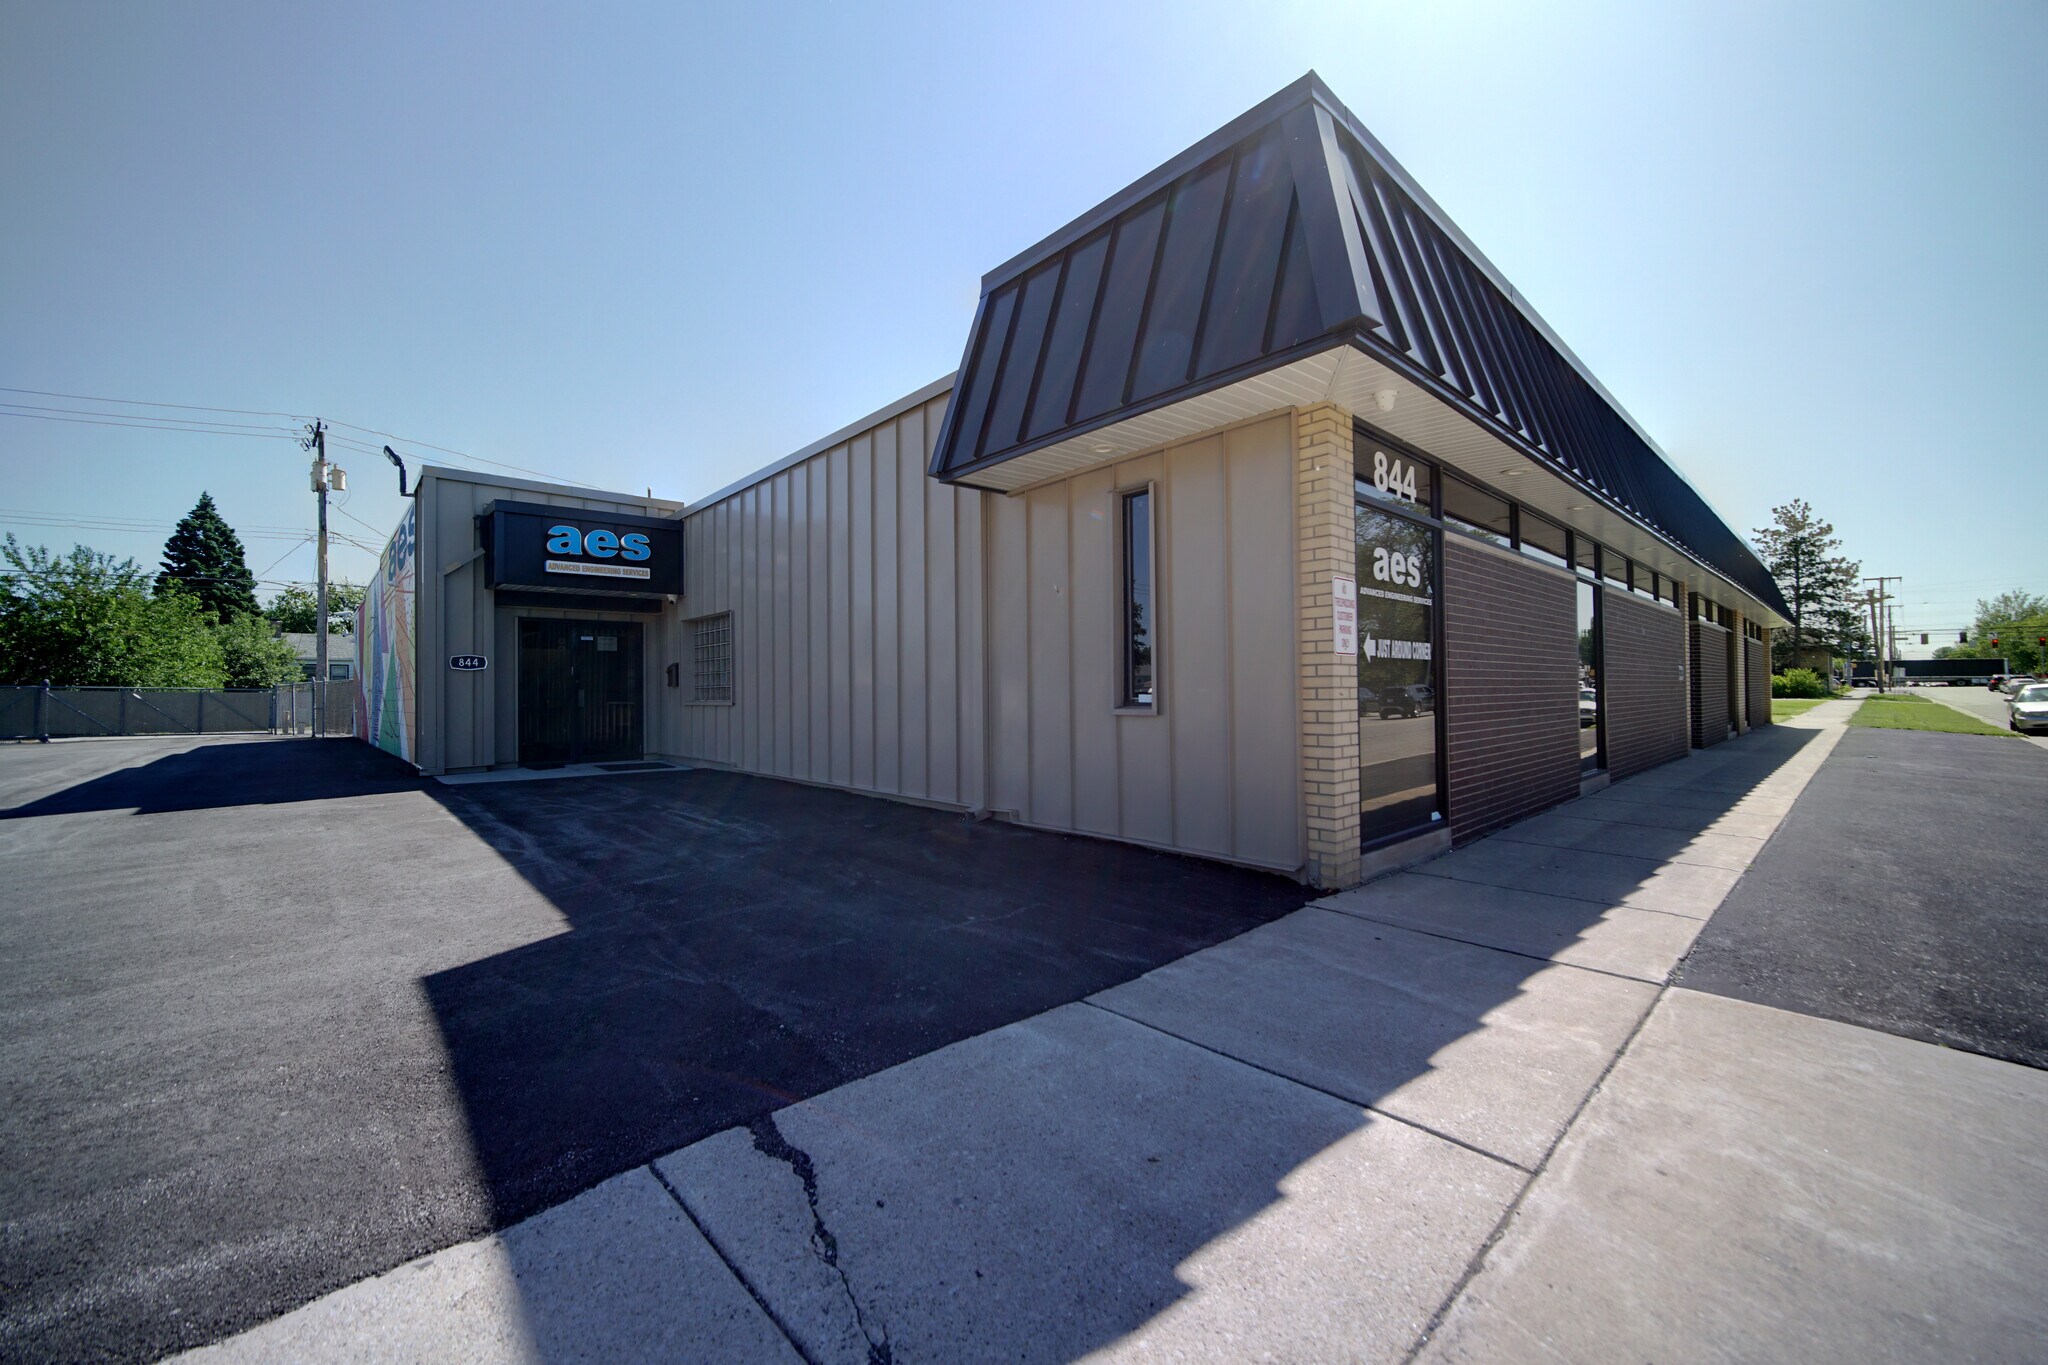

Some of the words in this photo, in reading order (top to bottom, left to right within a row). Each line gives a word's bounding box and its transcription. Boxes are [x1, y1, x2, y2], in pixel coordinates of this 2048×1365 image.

[1374, 451, 1417, 503] 844
[546, 525, 651, 561] aes
[548, 562, 581, 572] ADVANCED
[582, 565, 621, 575] ENGINEERING
[622, 568, 649, 578] SERVICES
[1373, 547, 1421, 588] aes
[1360, 587, 1384, 598] ADVANCED
[1385, 591, 1413, 603] ENGINEERING
[1413, 596, 1432, 606] SERVICES
[1377, 639, 1391, 659] JUST
[1391, 640, 1412, 659] AROUND
[1412, 641, 1432, 660] CORNER
[459, 657, 479, 667] 844
